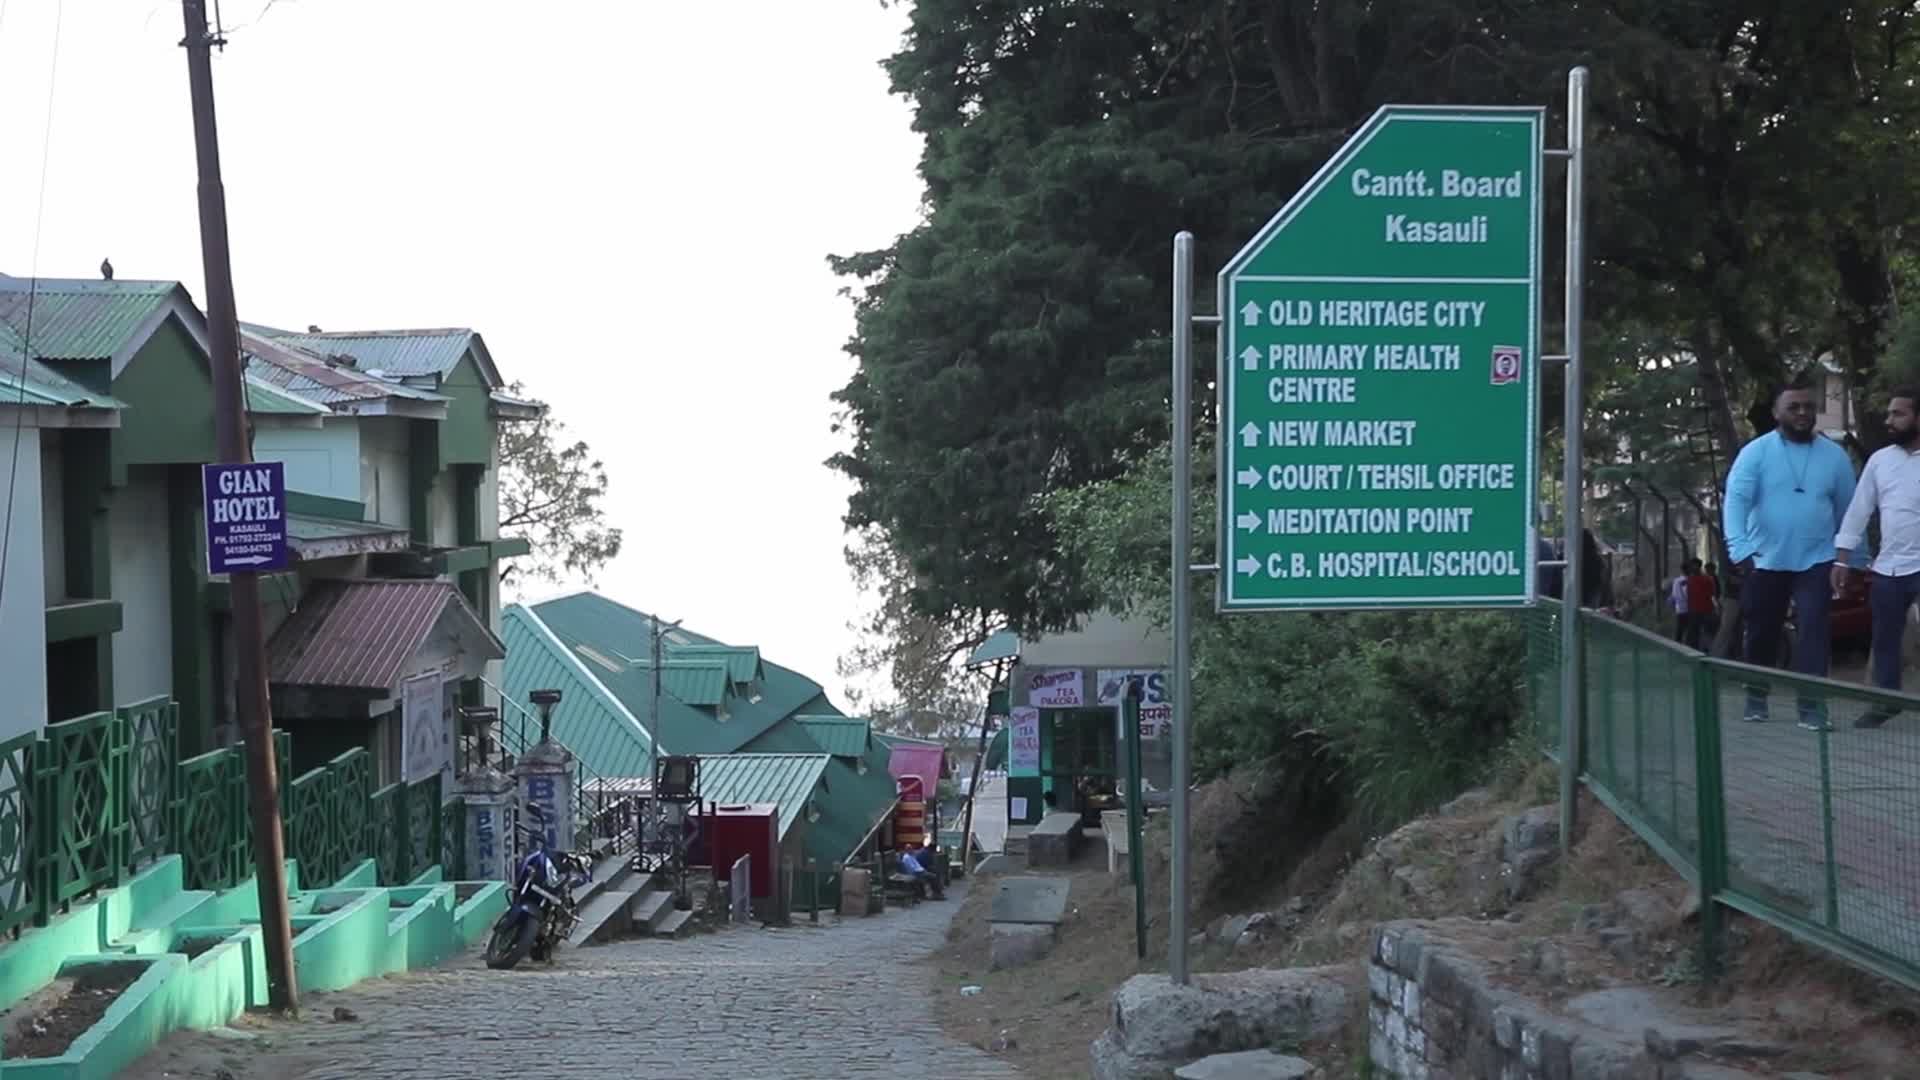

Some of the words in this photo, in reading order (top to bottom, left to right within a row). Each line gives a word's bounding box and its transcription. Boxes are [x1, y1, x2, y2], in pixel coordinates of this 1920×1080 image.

[1351, 168, 1434, 197] Cantt.
[1441, 169, 1521, 198] Board
[1385, 214, 1487, 243] Kasauli
[1269, 300, 1312, 326] OLD
[1319, 300, 1428, 327] HERITAGE
[1433, 300, 1486, 327] CITY
[1269, 344, 1368, 370] PRIMARY
[1374, 344, 1460, 370] HEALTH
[1268, 376, 1356, 403] CENTRE
[1268, 420, 1318, 447] NEW
[1324, 420, 1416, 447] MARKET
[219, 470, 271, 494] GIAN
[1268, 464, 1342, 491] COURT
[1358, 464, 1433, 490] TEHSIL
[1438, 463, 1514, 490] OFFICE
[213, 496, 280, 523] HOTEL
[1267, 507, 1400, 534] MEDITATION
[1406, 507, 1473, 533] POINT
[230, 524, 266, 533] KASAULI
[1267, 552, 1312, 579] C.B.
[1318, 550, 1521, 578] HOSPITAL/SCHOOL
[1041, 697, 1080, 705] PAKORA
[1057, 688, 1074, 697] TEA
[1018, 726, 1034, 737] TEA
